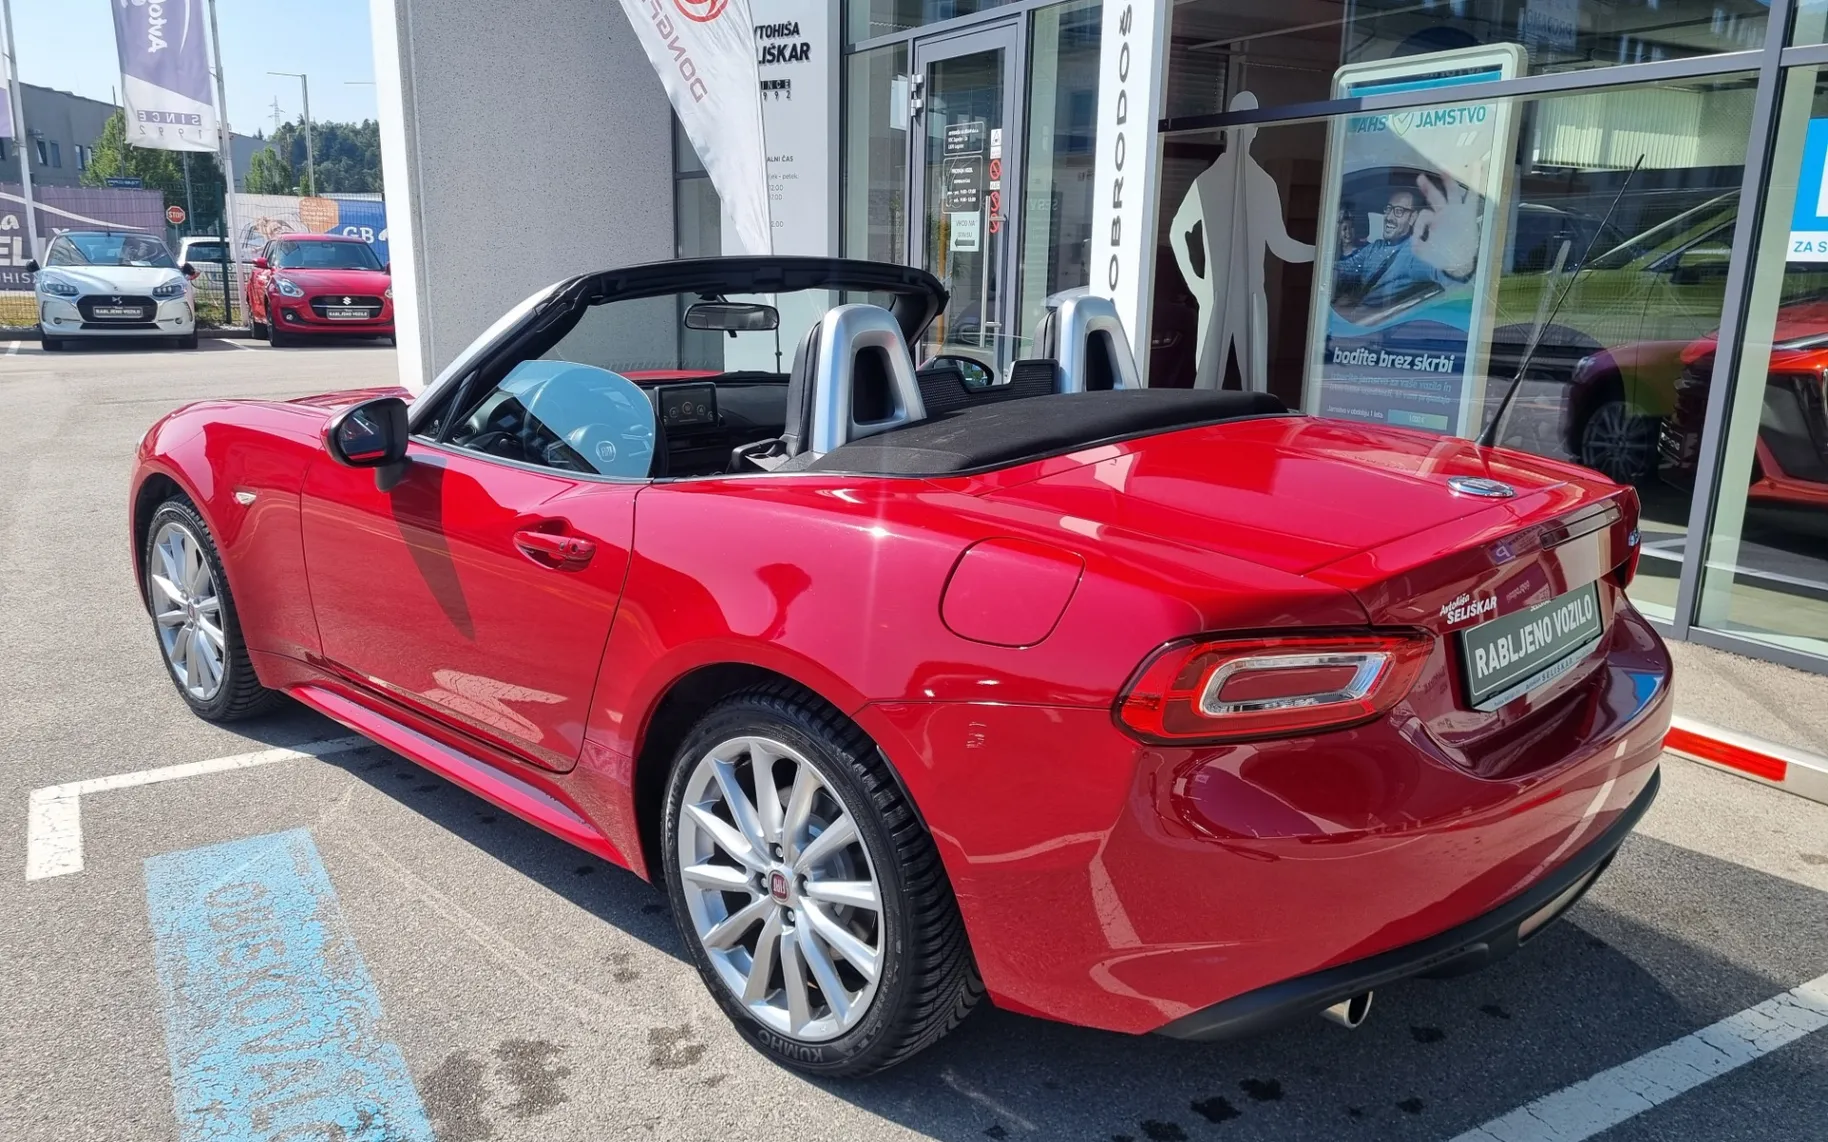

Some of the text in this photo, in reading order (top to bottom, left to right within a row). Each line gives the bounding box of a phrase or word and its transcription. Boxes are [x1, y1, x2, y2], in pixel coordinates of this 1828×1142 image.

[758, 42, 810, 64] IŠKAR
[762, 79, 791, 90] INCE
[763, 90, 791, 101] 992
[1357, 105, 1486, 133] AHS JAMSTVO
[1109, 0, 1133, 306] OBRODOŠ
[168, 211, 185, 219] STOP
[343, 226, 374, 243] GB
[1793, 241, 1813, 253] ZA
[1333, 347, 1456, 373] bodite brez skrbi
[1447, 596, 1498, 625] SELIŠKAR
[1475, 594, 1593, 679] RABLJENO VOZILO
[757, 1028, 824, 1062] KUMHO
